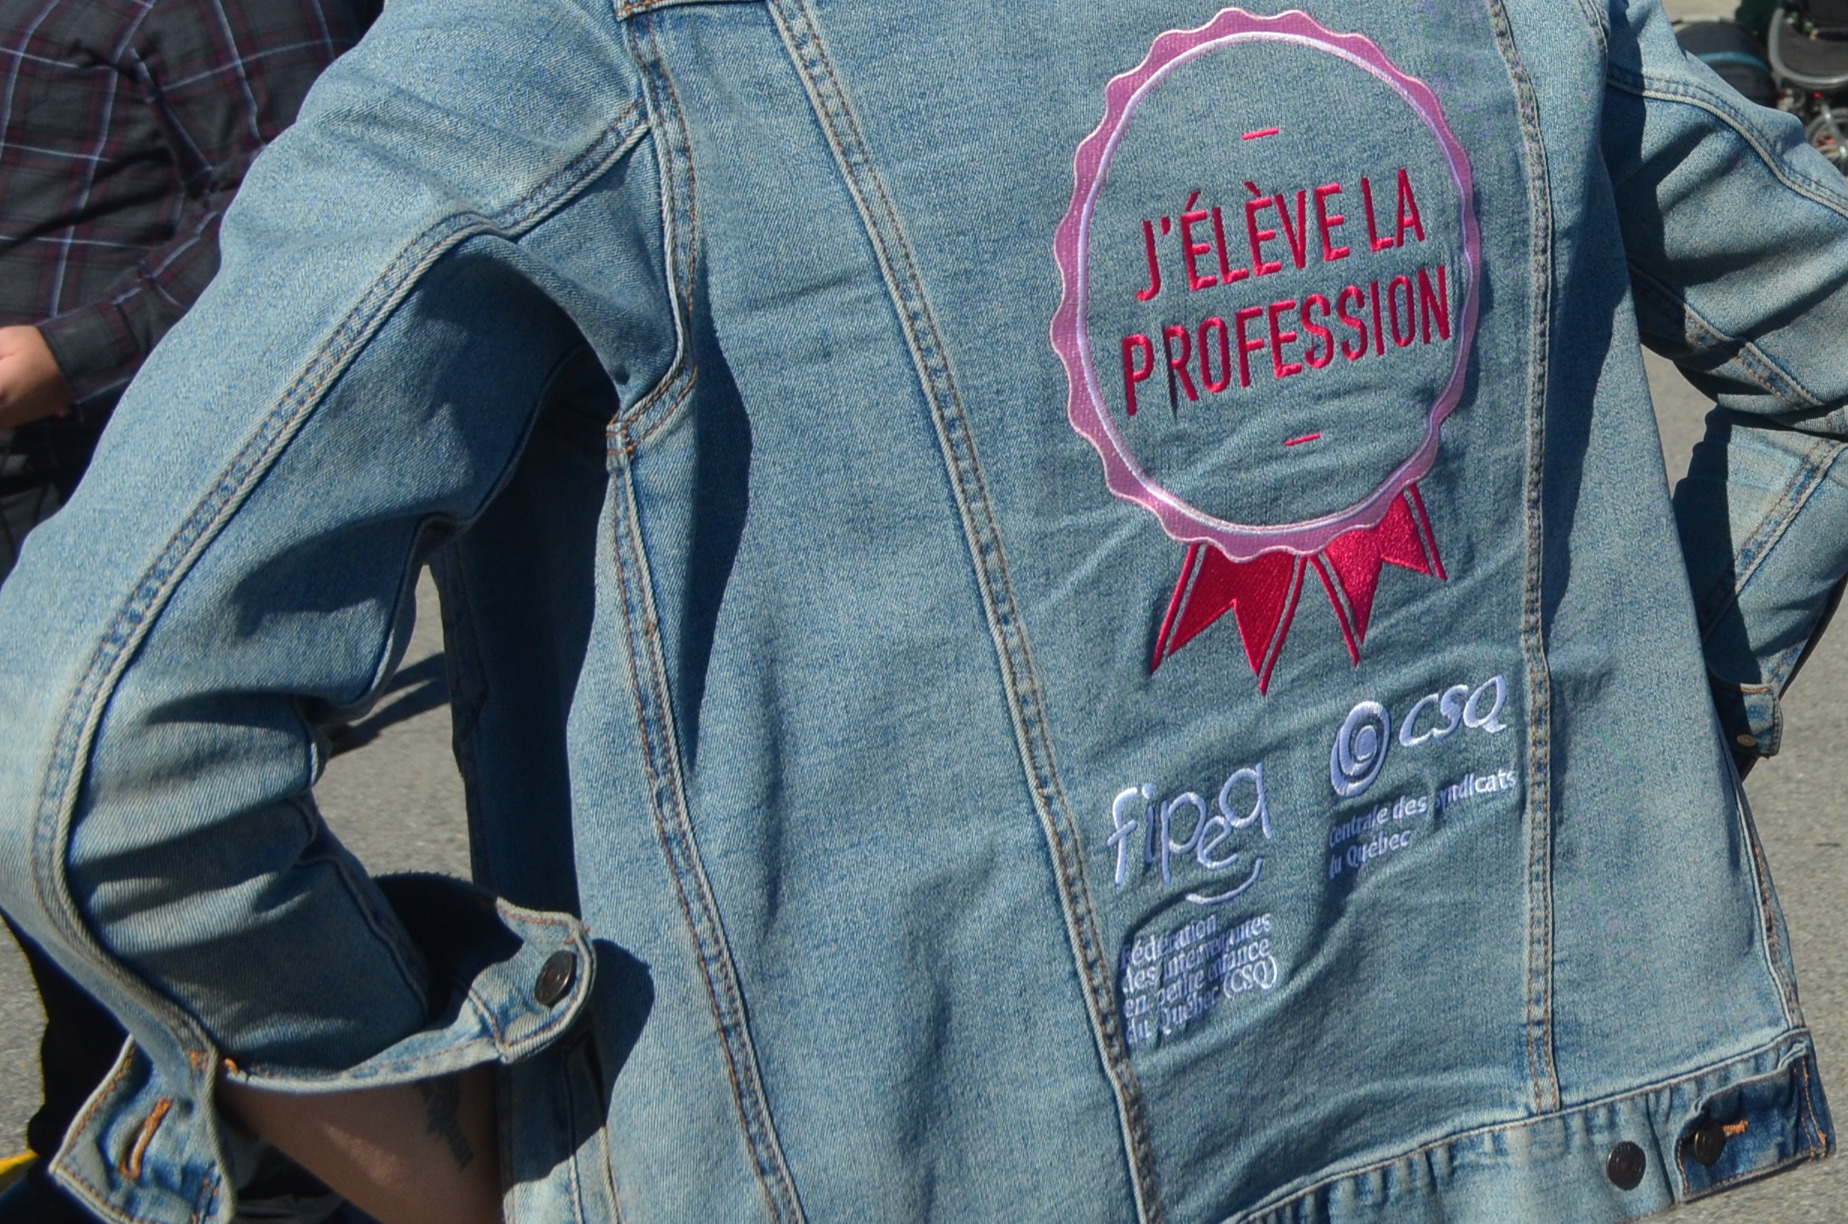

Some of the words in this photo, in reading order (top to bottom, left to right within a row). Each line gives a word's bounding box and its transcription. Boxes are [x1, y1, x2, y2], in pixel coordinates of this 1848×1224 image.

[1361, 168, 1425, 251] LA
[1121, 264, 1450, 418] PROFESSION
[1392, 794, 1428, 820] des
[1434, 768, 1518, 812] syndicats
[1346, 829, 1411, 868] Québec
[1121, 914, 1217, 969] Fédération
[1124, 995, 1147, 1018] en
[1126, 1017, 1151, 1044] du
[1223, 954, 1278, 999] (CSQ)
